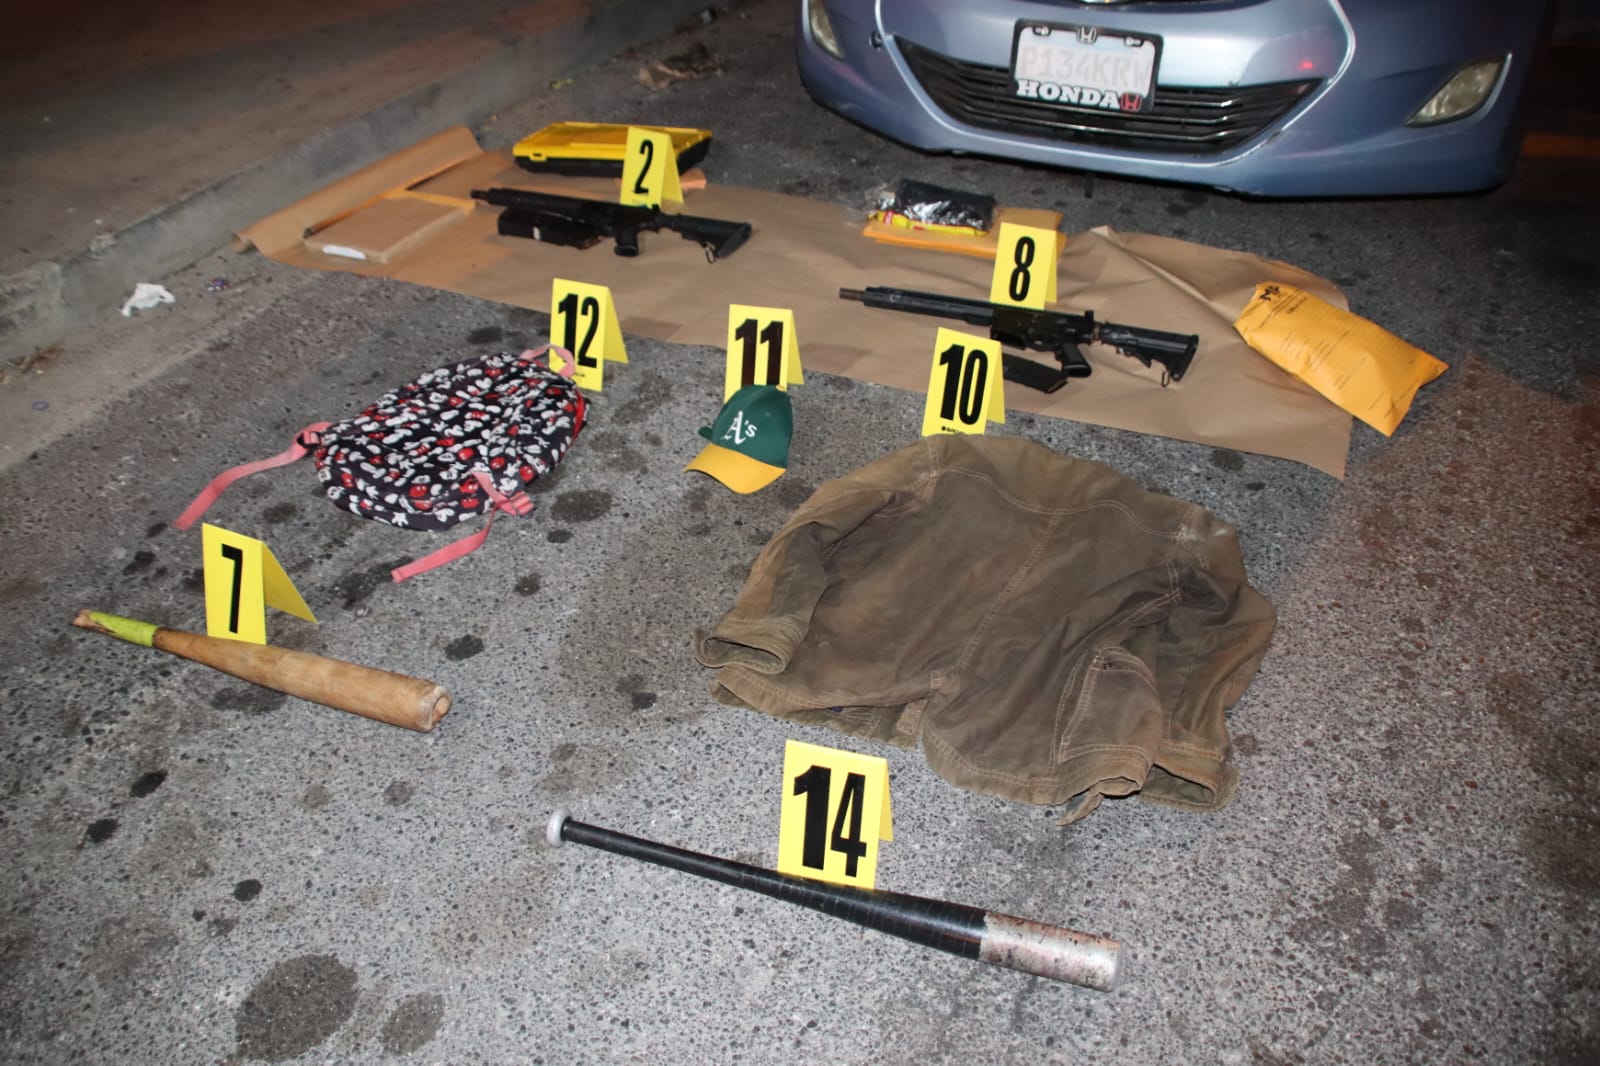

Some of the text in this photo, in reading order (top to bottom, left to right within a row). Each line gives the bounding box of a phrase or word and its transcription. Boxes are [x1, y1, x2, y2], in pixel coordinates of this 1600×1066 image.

[1016, 79, 1121, 110] HONDA
[634, 139, 654, 194] 2
[1009, 236, 1035, 301] 8
[558, 293, 600, 369] 12
[735, 318, 784, 387] 11
[939, 343, 988, 426] 10
[719, 410, 758, 444] A's
[221, 543, 243, 634] 7
[793, 765, 867, 878] 14
